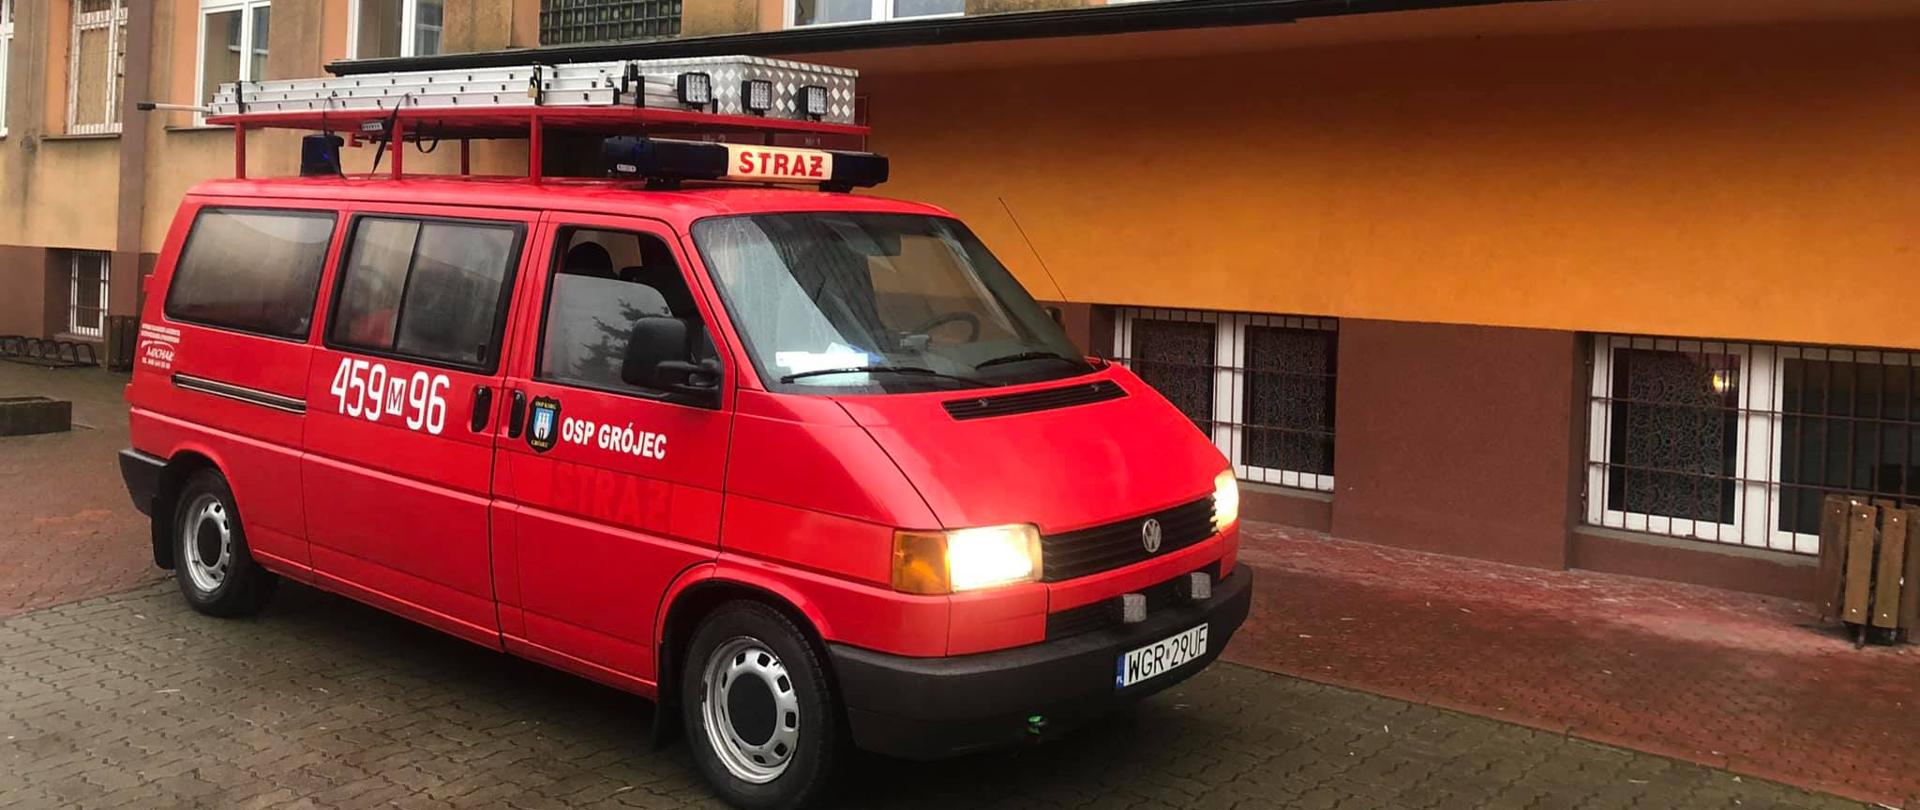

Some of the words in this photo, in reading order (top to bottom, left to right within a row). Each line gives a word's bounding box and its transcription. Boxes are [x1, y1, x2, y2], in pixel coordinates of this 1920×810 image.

[738, 151, 823, 177] STRAŻ
[562, 417, 596, 445] OSP
[597, 421, 667, 459] GRÓJEC
